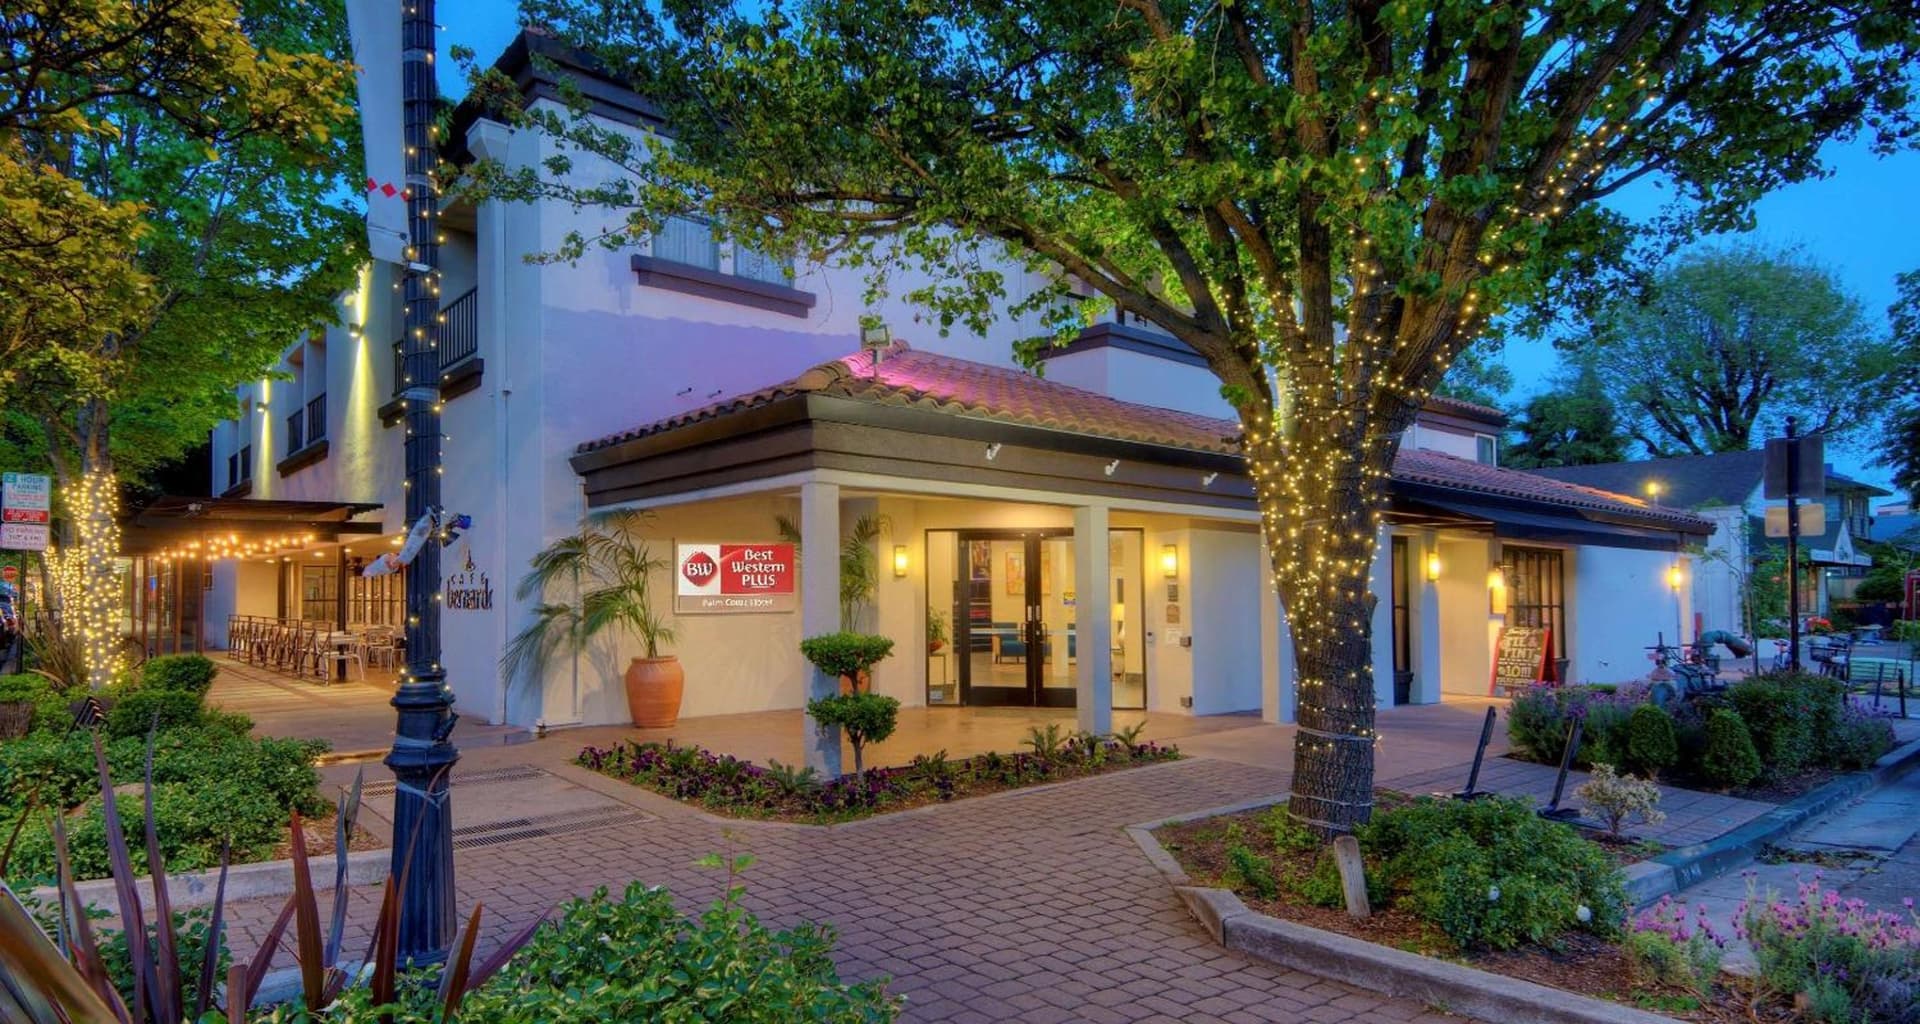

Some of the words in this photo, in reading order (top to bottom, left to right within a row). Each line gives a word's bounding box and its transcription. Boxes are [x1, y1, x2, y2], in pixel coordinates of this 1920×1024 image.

[744, 549, 773, 561] Best
[687, 562, 713, 577] BW
[731, 561, 785, 574] Western
[742, 574, 775, 587] PLUS
